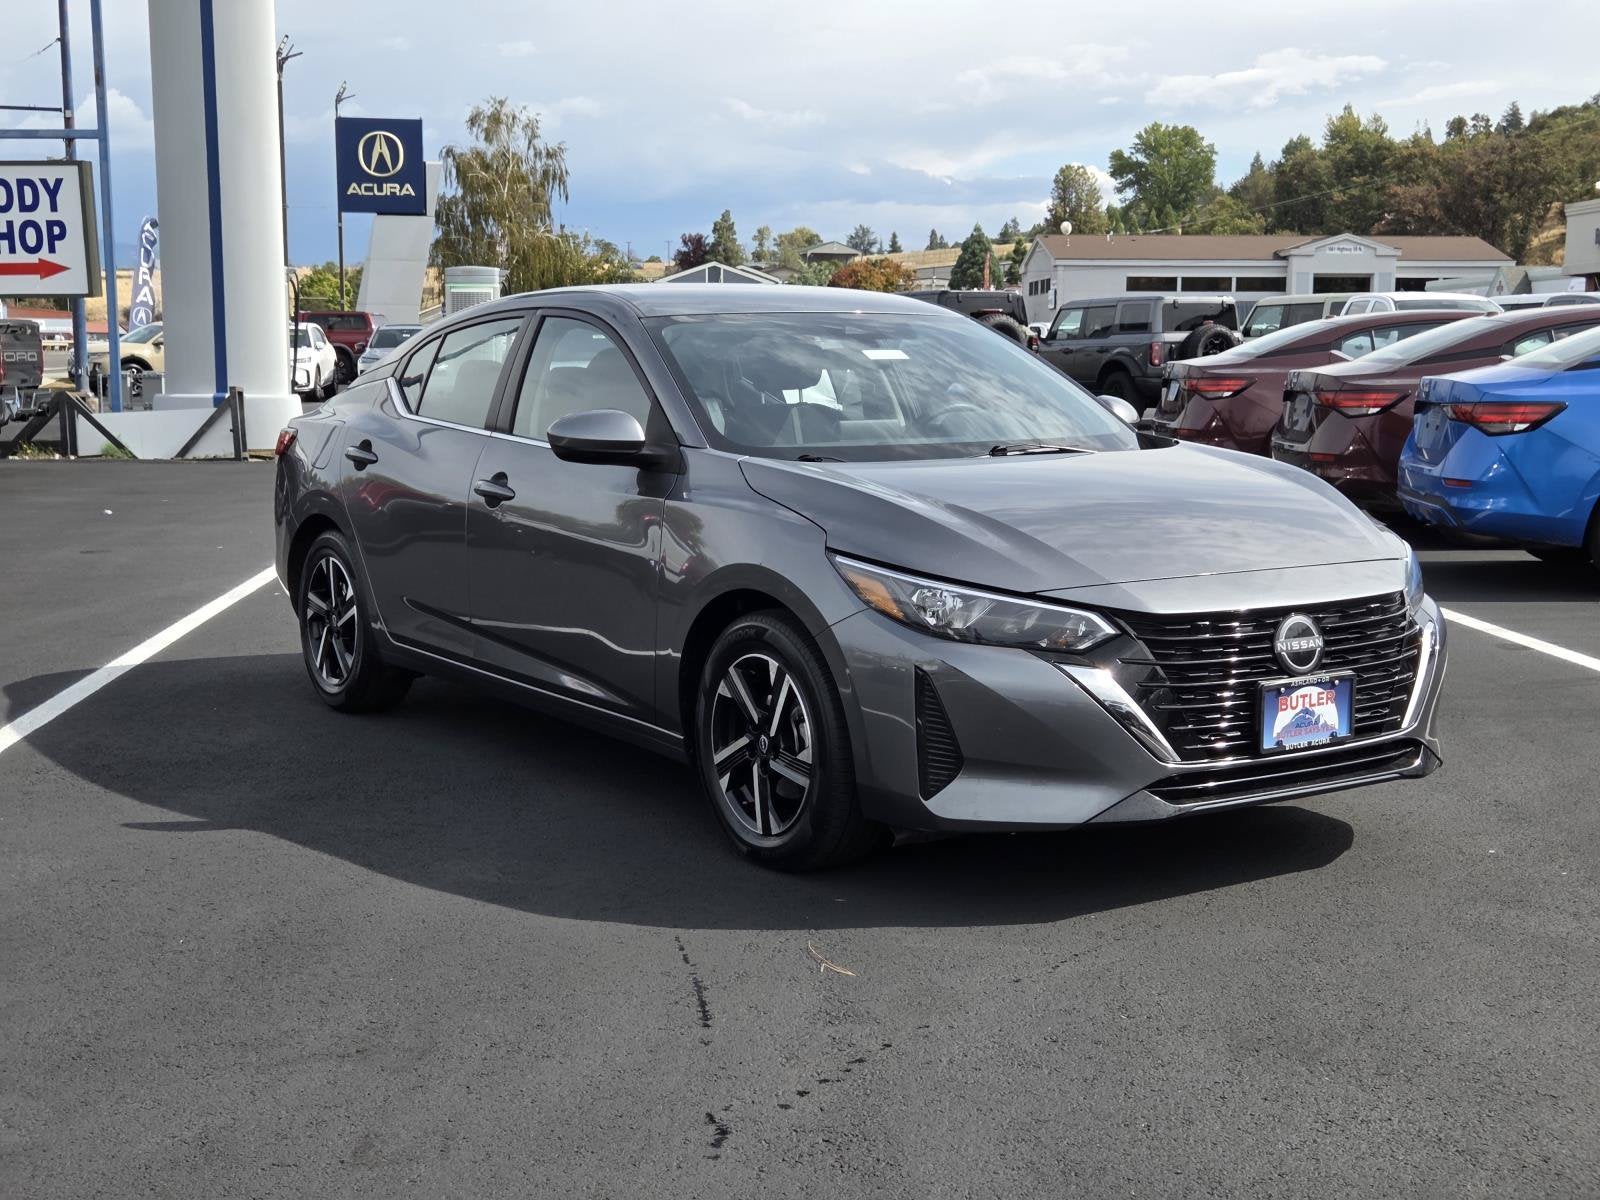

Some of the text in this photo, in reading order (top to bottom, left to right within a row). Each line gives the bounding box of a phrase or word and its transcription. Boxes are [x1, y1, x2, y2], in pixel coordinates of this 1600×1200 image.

[346, 182, 416, 197] ACURA
[1277, 638, 1323, 651] NISSAN
[1279, 690, 1336, 712] BUTLER
[1295, 720, 1319, 729] ACURA
[1285, 738, 1331, 751] BUTLER ACURA
